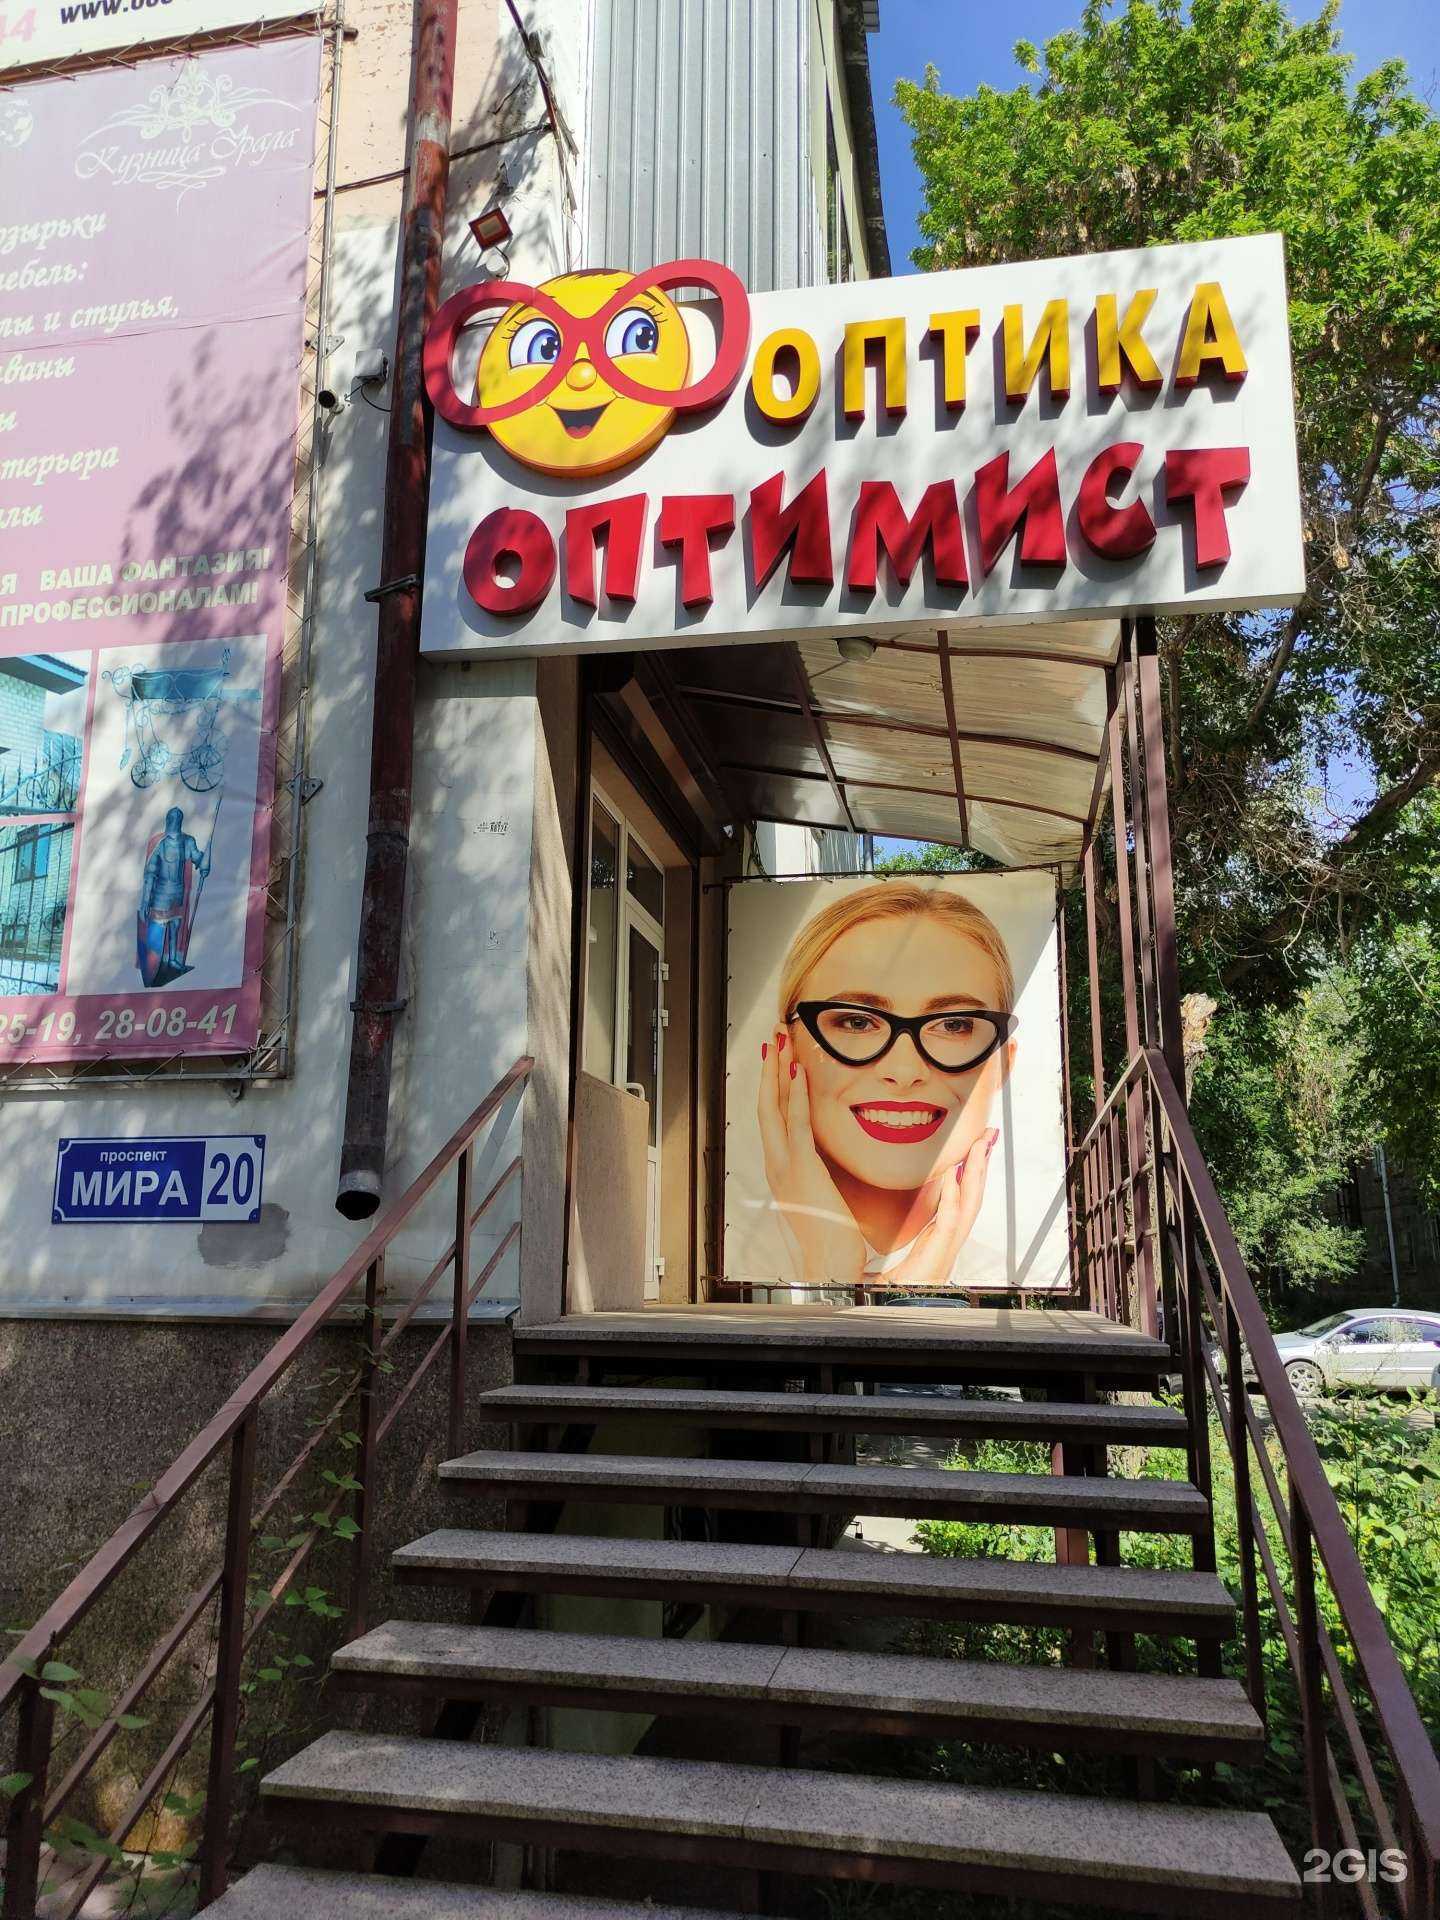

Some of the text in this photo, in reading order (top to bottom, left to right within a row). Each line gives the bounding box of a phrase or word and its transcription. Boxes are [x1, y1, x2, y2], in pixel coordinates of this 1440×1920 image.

[75, 125, 301, 185] Кузница Урала
[44, 311, 61, 332] и
[70, 295, 179, 334] стулья,
[752, 281, 1249, 426] ОПТИКА
[463, 441, 1252, 617] ОПТИМИСТ
[39, 563, 114, 592] ВАША
[120, 547, 273, 583] ФАНТАЗИЯ!
[0, 582, 259, 627] ПРОФЕССИОНАЛАМ!
[94, 1003, 238, 1041] 28-08-41
[99, 1149, 168, 1164] проспект
[71, 1152, 255, 1207] МИРА 20
